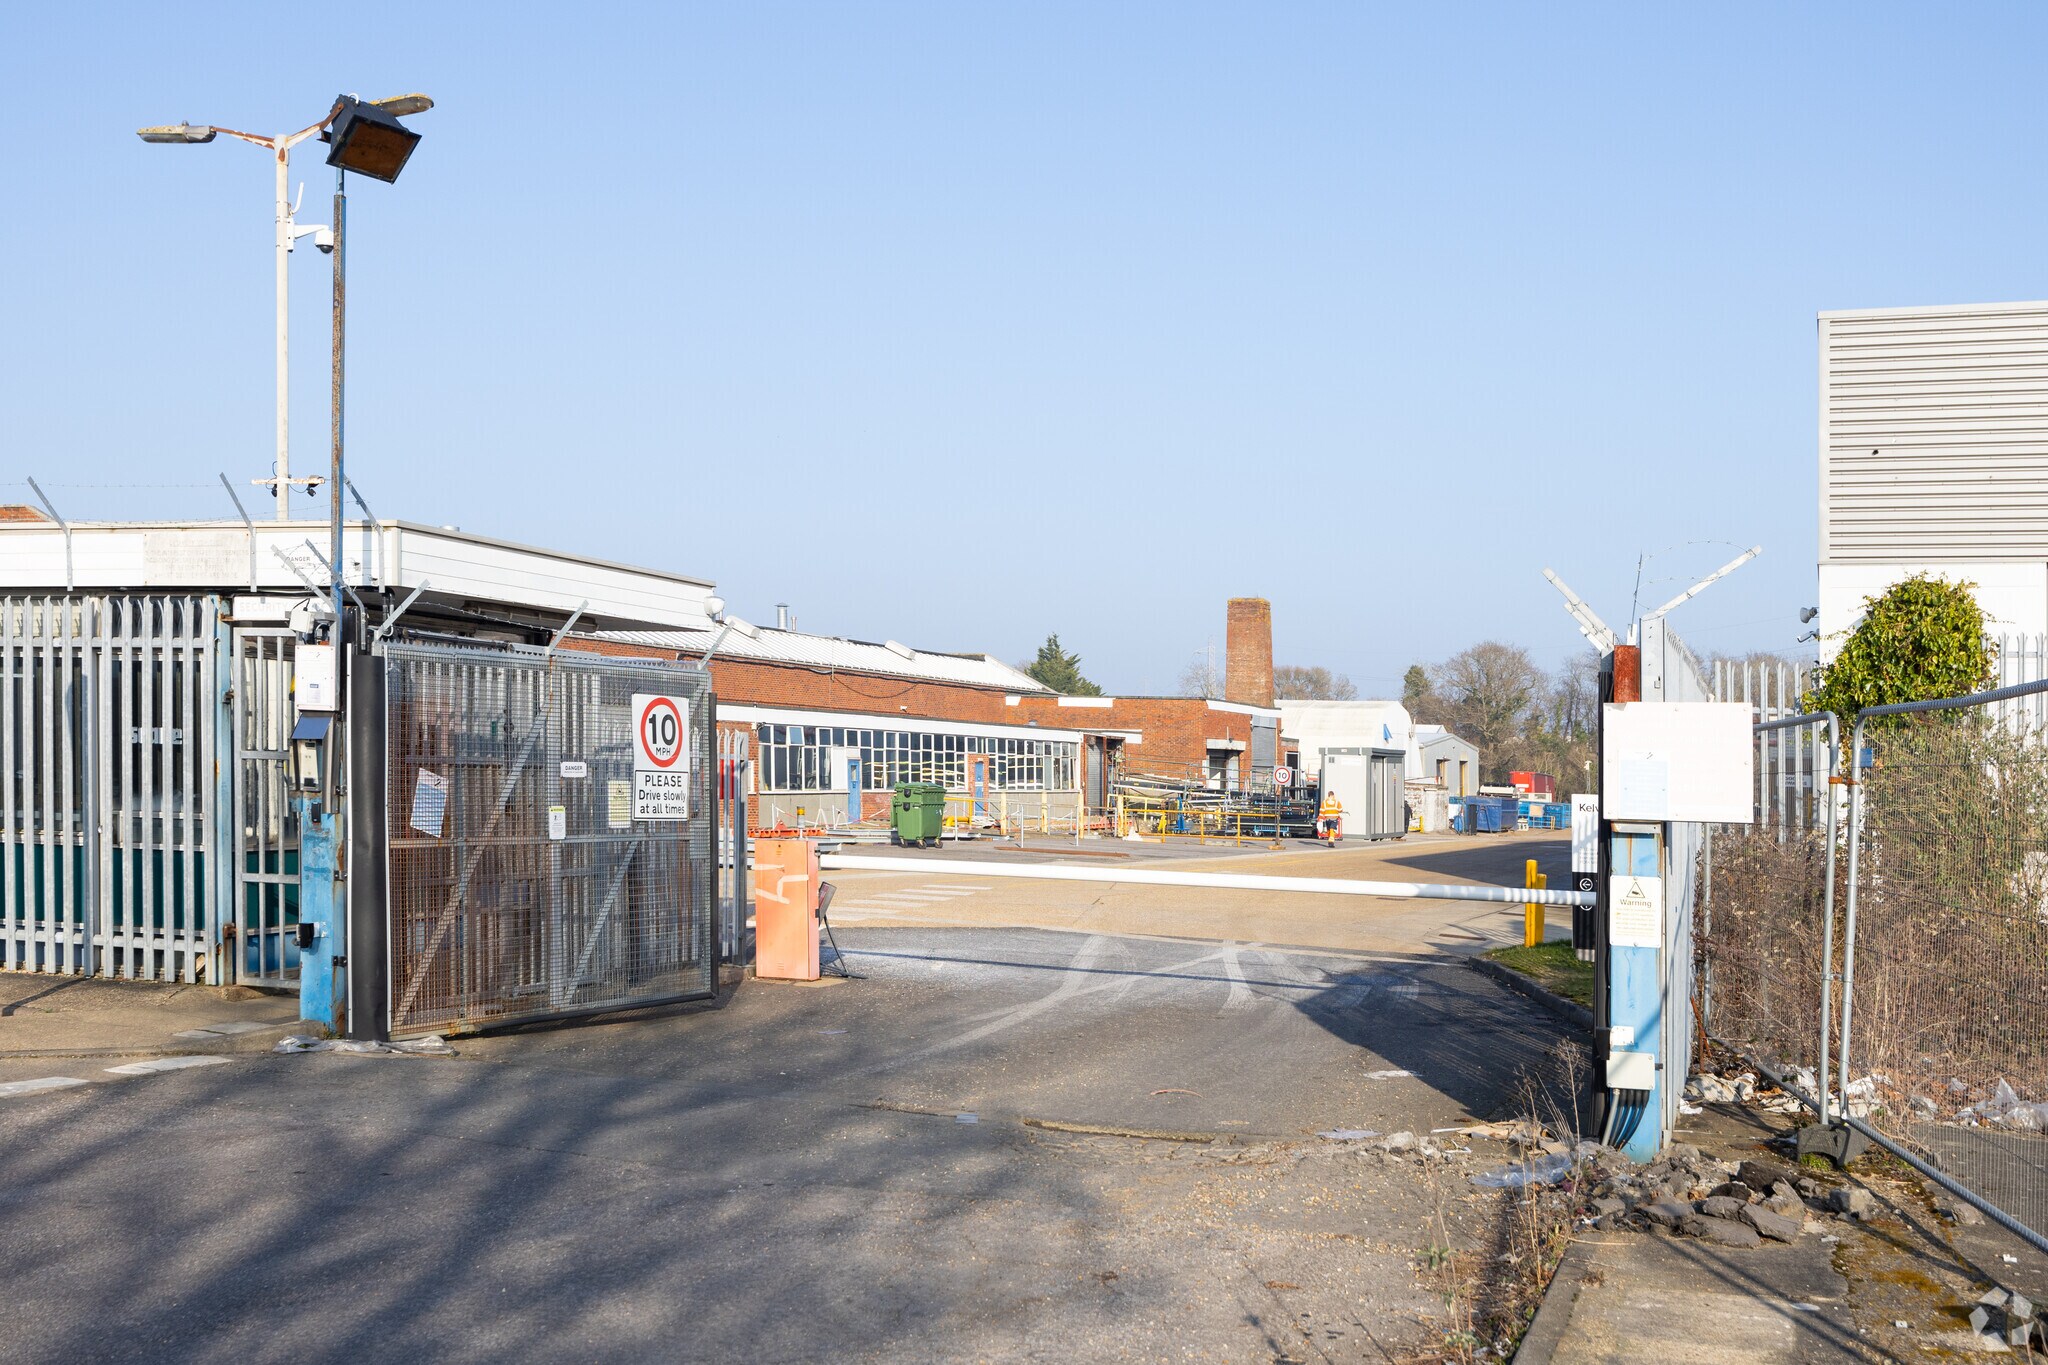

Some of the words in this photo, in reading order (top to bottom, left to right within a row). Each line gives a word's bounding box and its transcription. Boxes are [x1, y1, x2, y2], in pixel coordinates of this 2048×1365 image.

[240, 602, 288, 612] SECURITY
[648, 713, 676, 746] 10
[655, 747, 671, 757] MPH
[645, 774, 682, 787] PLEASE
[639, 789, 661, 801] Drive
[663, 789, 687, 803] slowly
[640, 804, 650, 814] at
[652, 803, 663, 814] all
[665, 804, 685, 815] times
[1620, 899, 1652, 908] Warning
